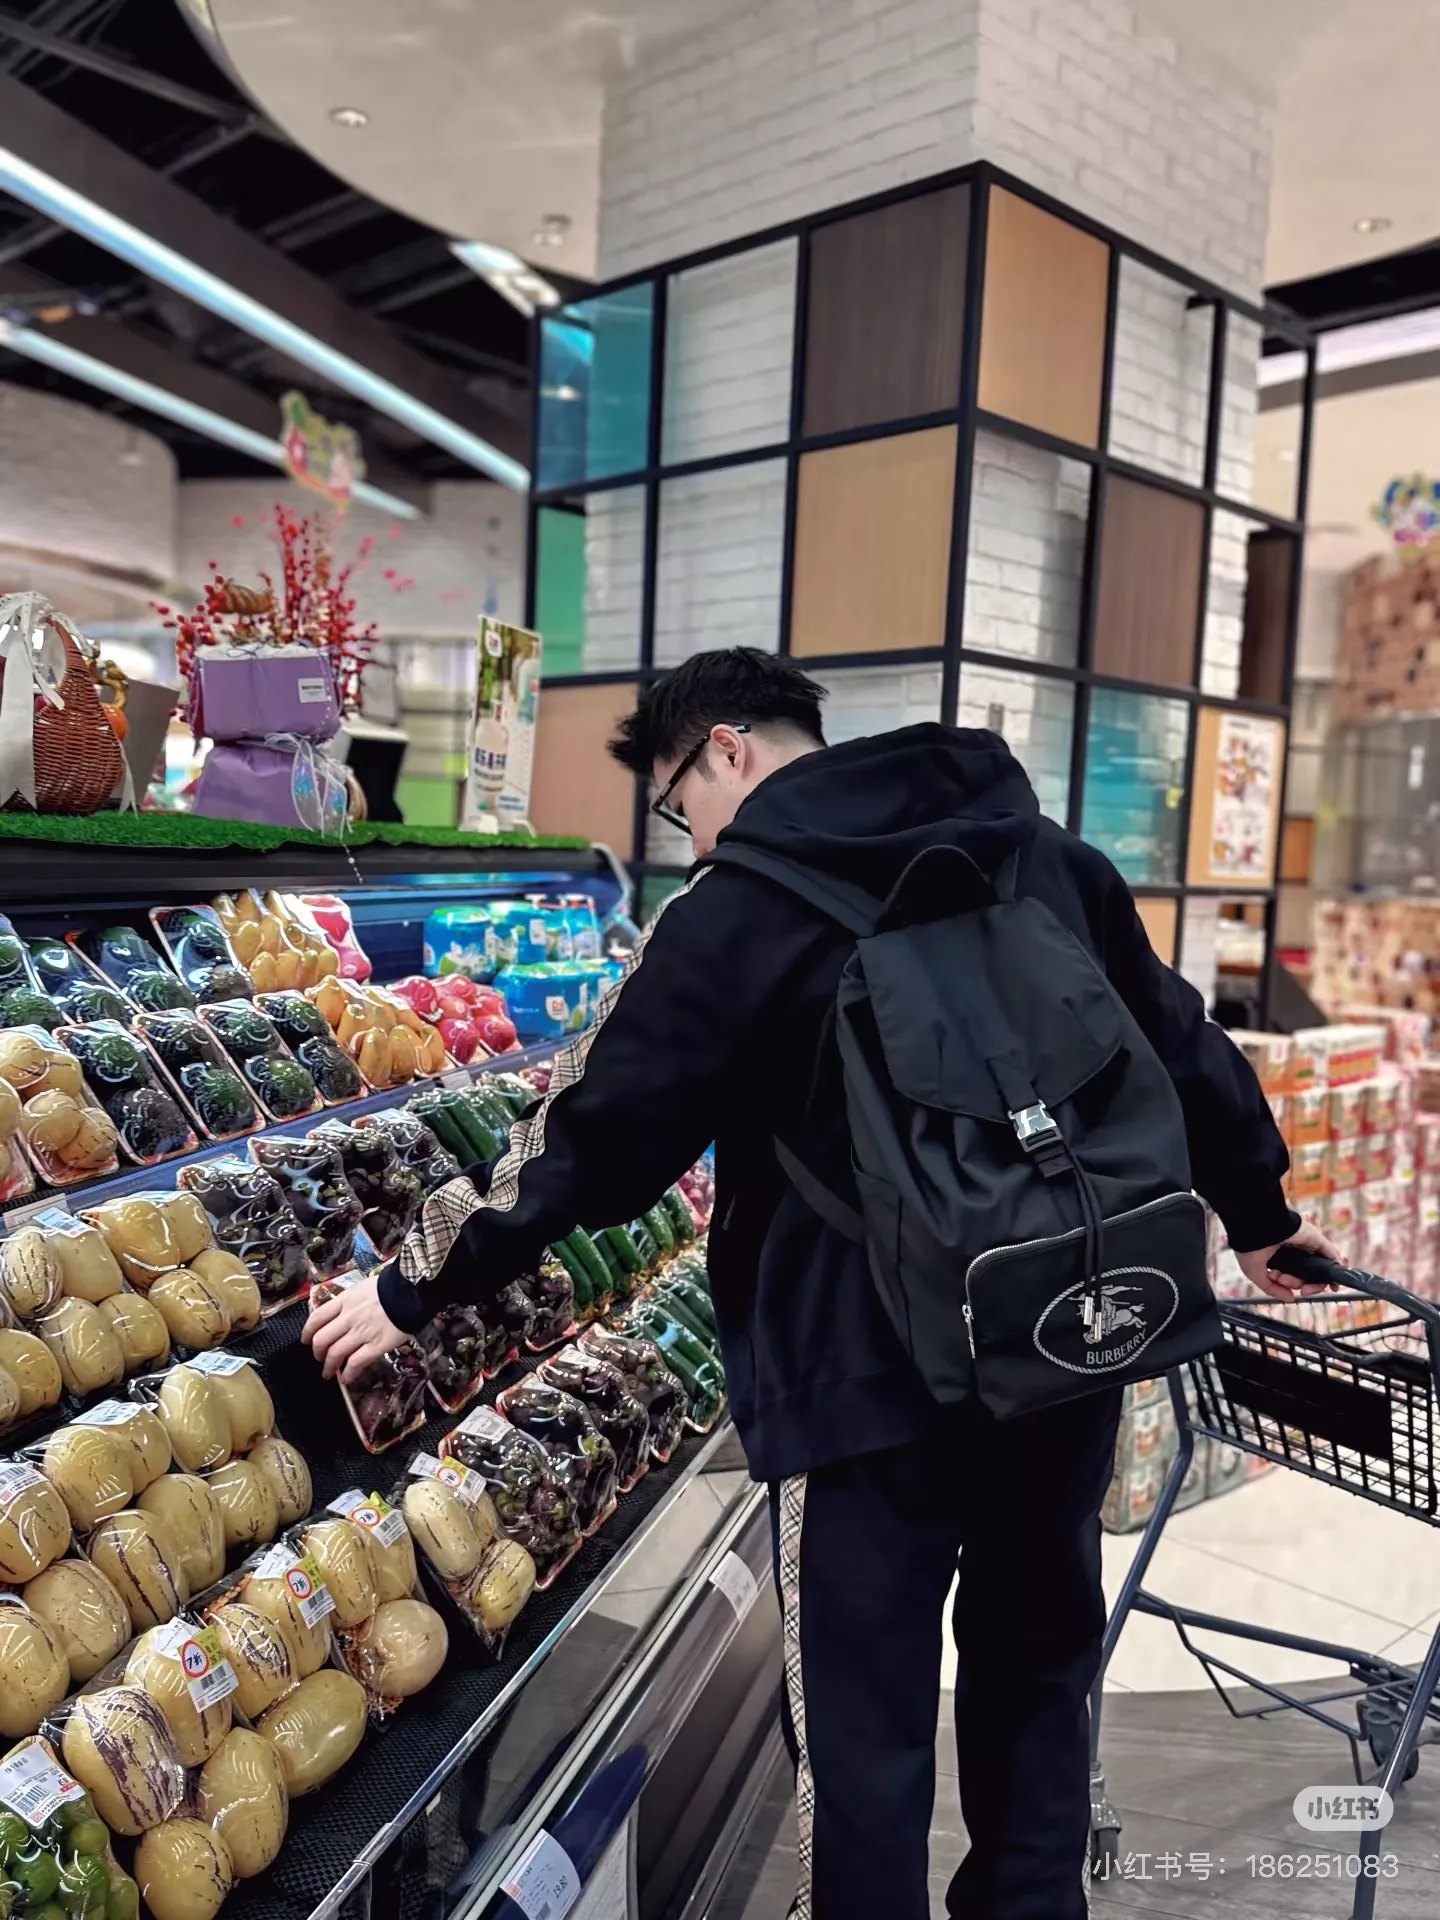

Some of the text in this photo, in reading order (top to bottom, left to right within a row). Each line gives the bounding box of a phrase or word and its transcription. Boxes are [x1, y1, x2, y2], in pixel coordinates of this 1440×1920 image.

[1086, 1327, 1146, 1365] BURBERRY
[292, 1577, 307, 1592] 7折
[185, 1651, 202, 1669] 7折
